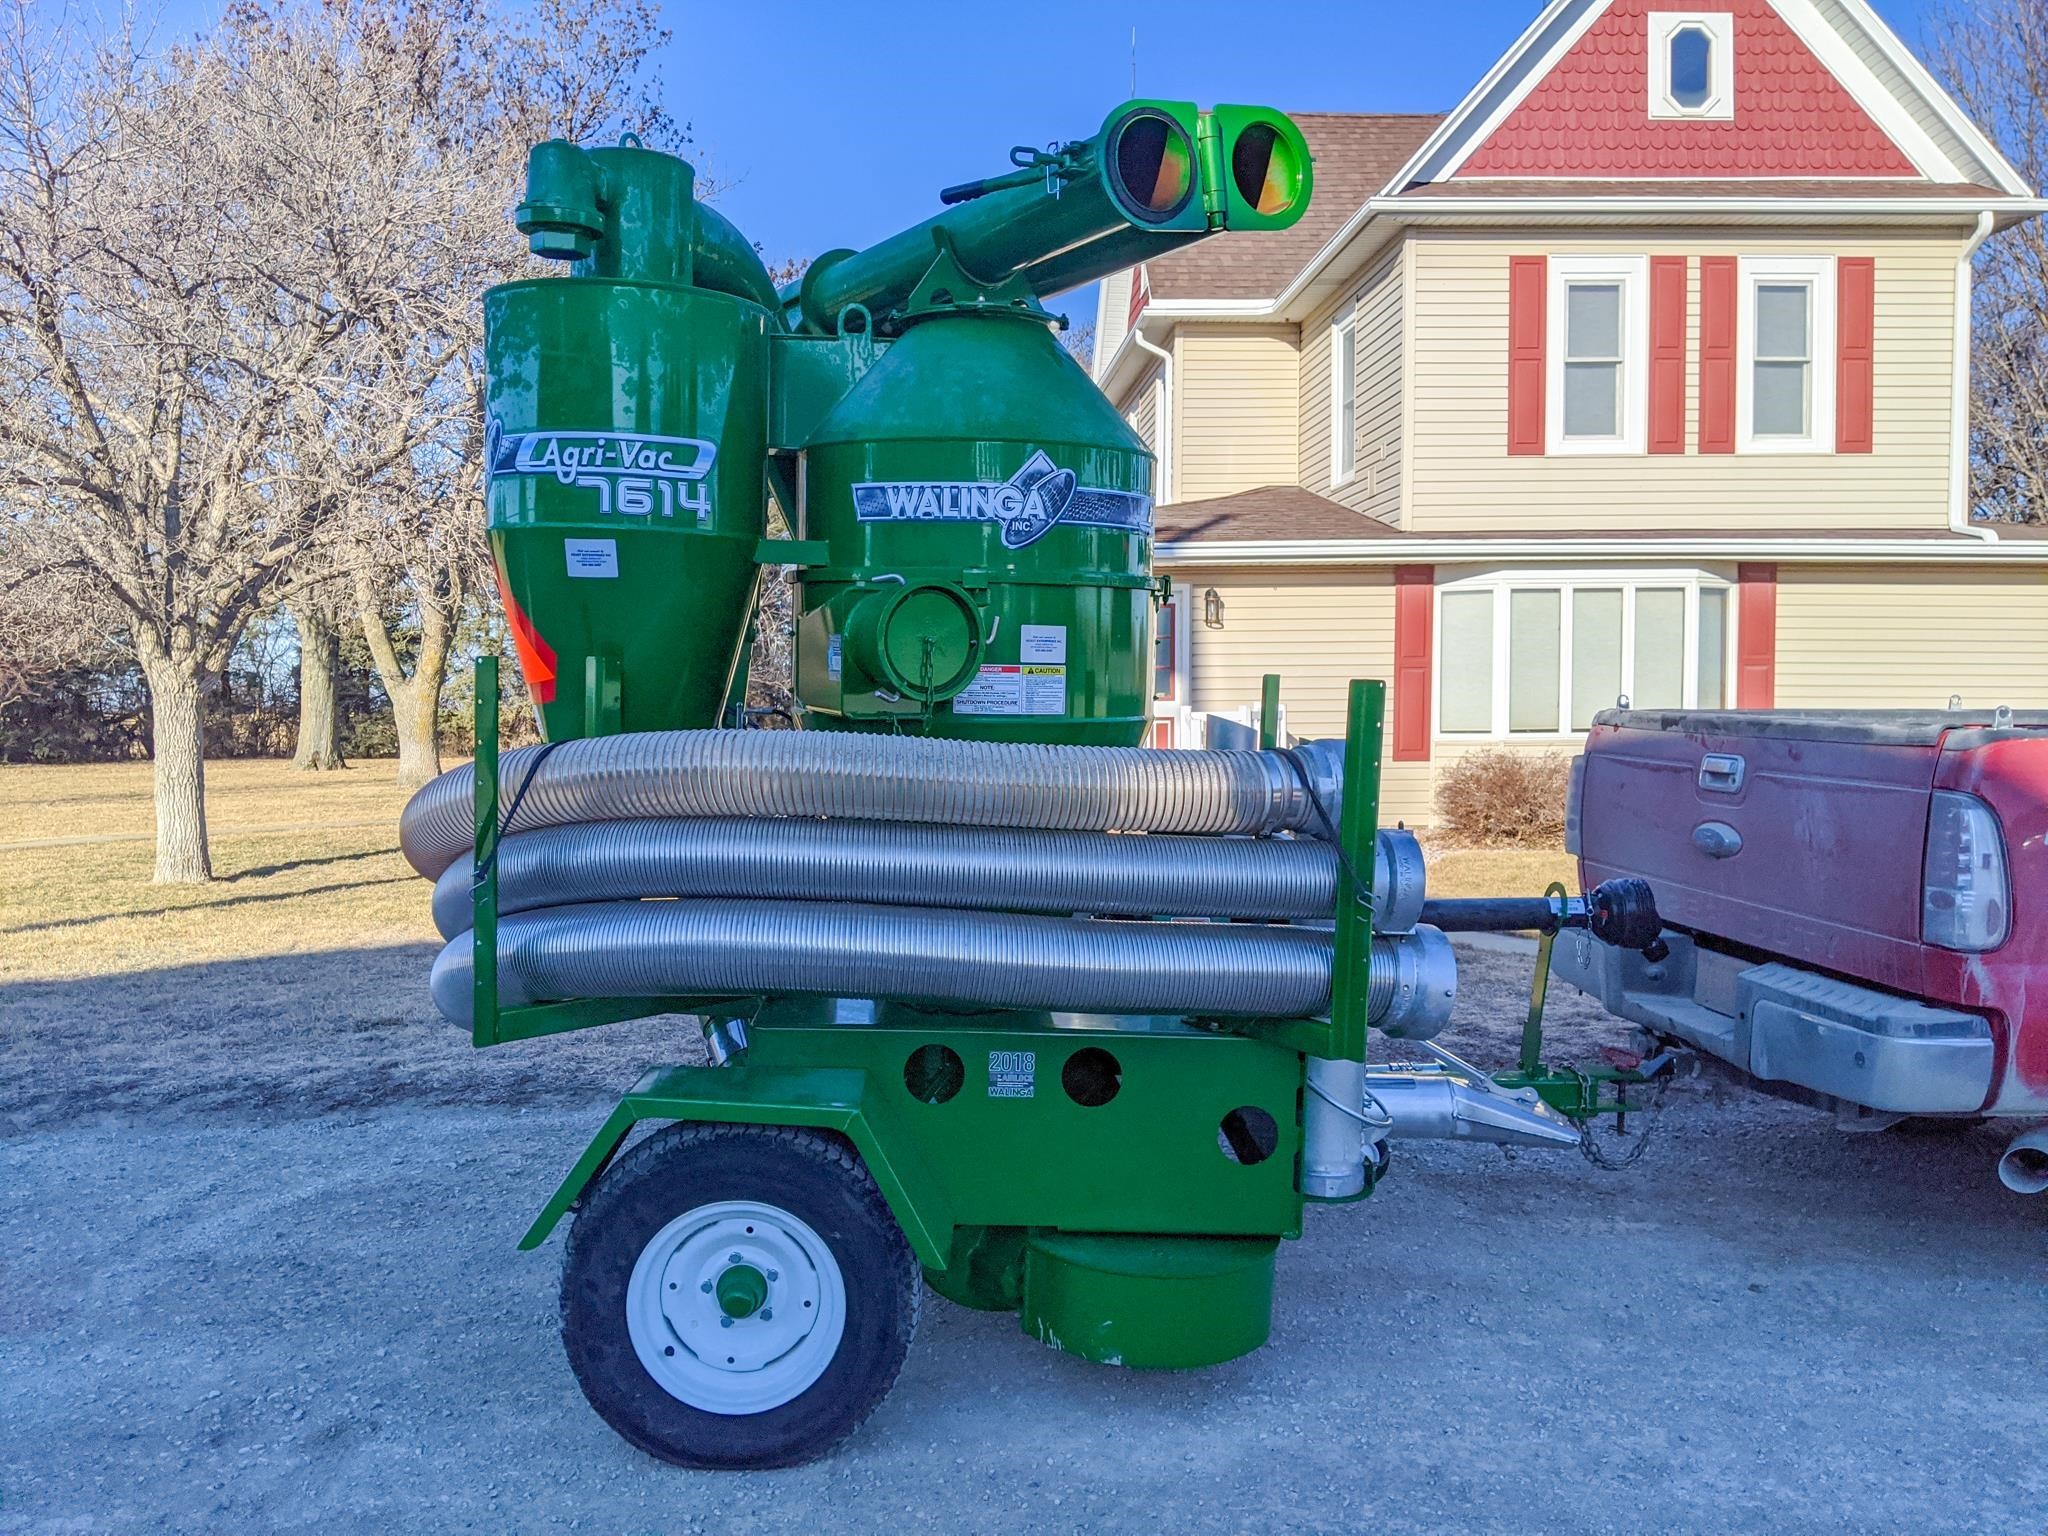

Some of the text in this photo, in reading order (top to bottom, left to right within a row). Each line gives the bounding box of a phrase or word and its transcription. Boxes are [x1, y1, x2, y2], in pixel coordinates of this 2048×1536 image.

[541, 438, 674, 484] Agri-Vac
[575, 476, 711, 521] 7614
[885, 485, 1048, 520] WALINGA
[1011, 520, 1034, 532] INC.
[988, 1052, 1035, 1072] 2018
[988, 1086, 1034, 1097] WALINGA
